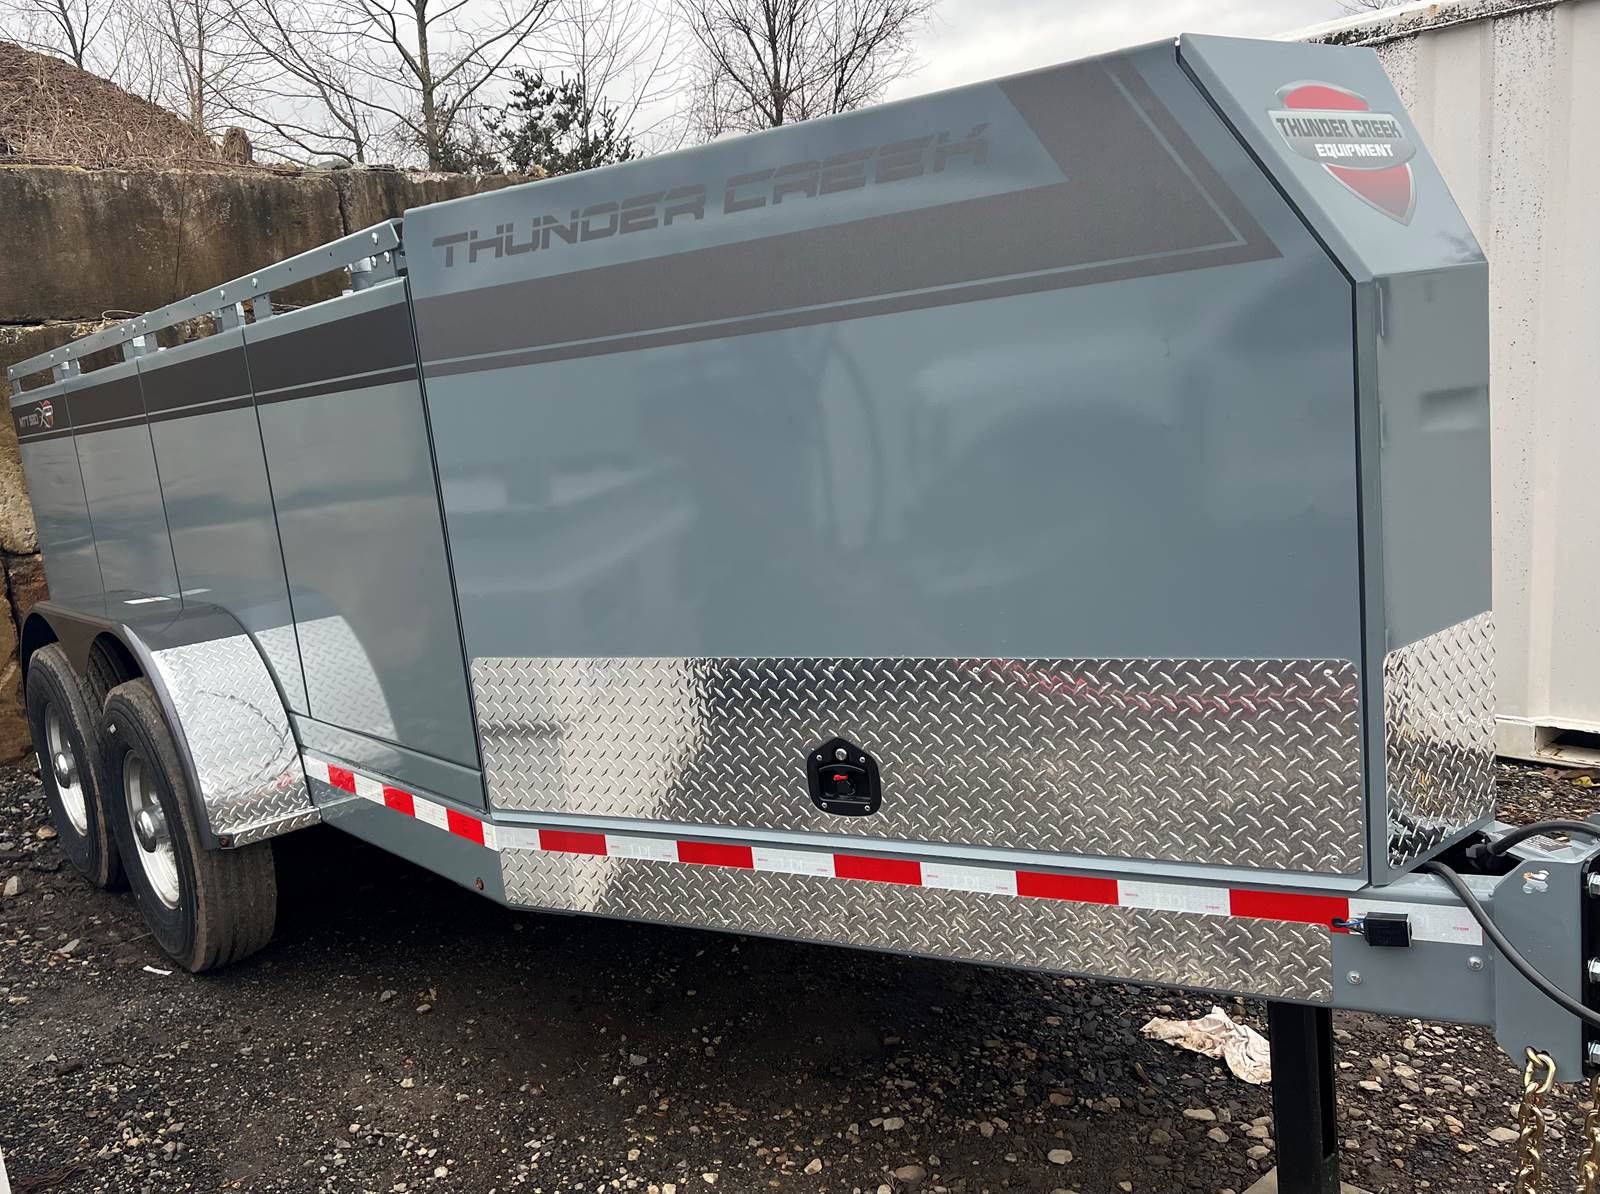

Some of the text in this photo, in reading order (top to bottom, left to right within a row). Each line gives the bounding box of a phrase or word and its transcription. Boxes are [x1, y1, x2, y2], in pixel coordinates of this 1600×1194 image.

[1276, 118, 1402, 138] THUNDER CREEK
[1315, 144, 1394, 158] EQUIPMENT
[432, 121, 990, 268] THUNDER CREEK
